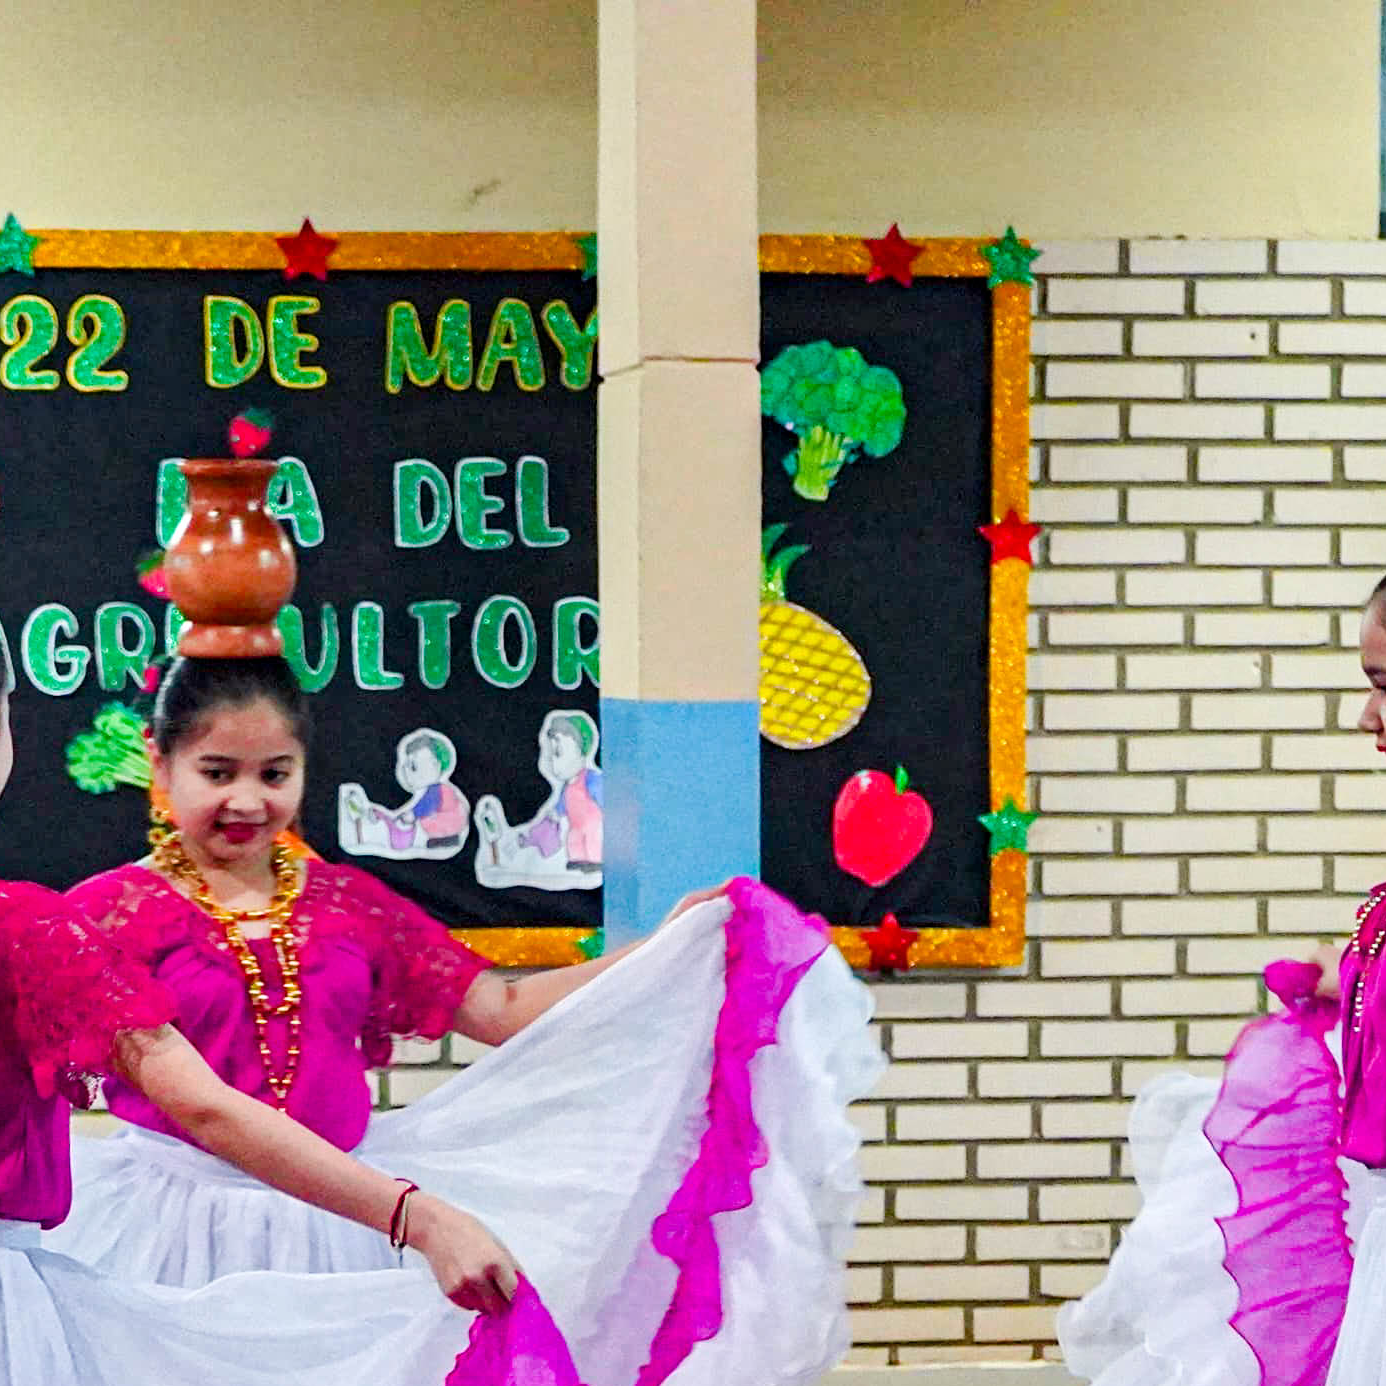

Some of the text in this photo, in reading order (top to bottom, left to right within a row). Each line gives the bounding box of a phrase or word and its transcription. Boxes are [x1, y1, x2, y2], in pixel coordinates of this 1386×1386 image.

[203, 294, 327, 391] DE
[385, 297, 600, 394] MAY
[393, 456, 570, 549] DEL
